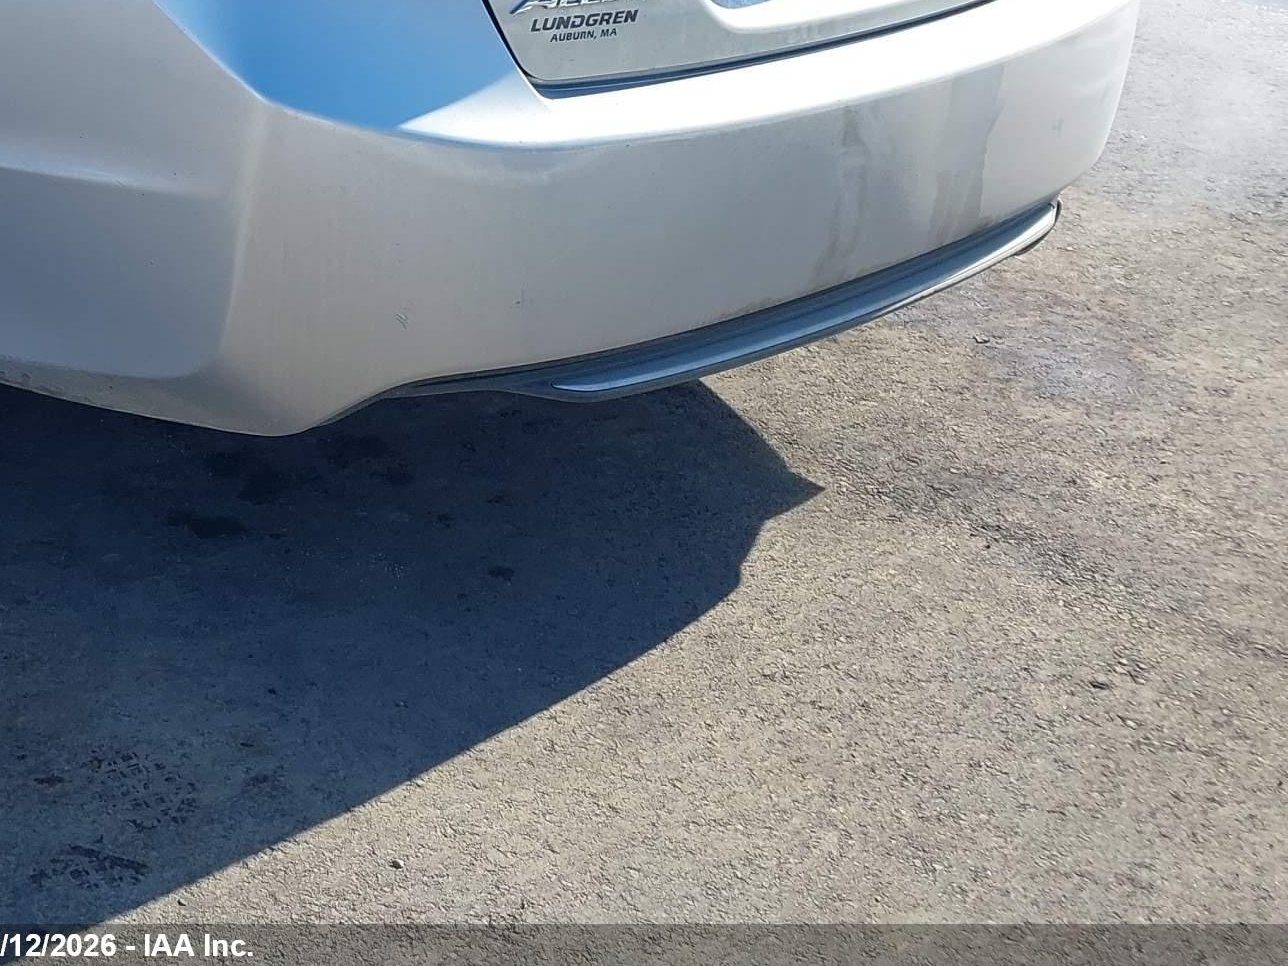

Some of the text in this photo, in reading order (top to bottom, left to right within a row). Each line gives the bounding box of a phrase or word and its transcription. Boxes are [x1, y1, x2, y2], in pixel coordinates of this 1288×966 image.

[530, 9, 639, 32] LUNDGREN
[549, 27, 617, 43] AUBURN, MA
